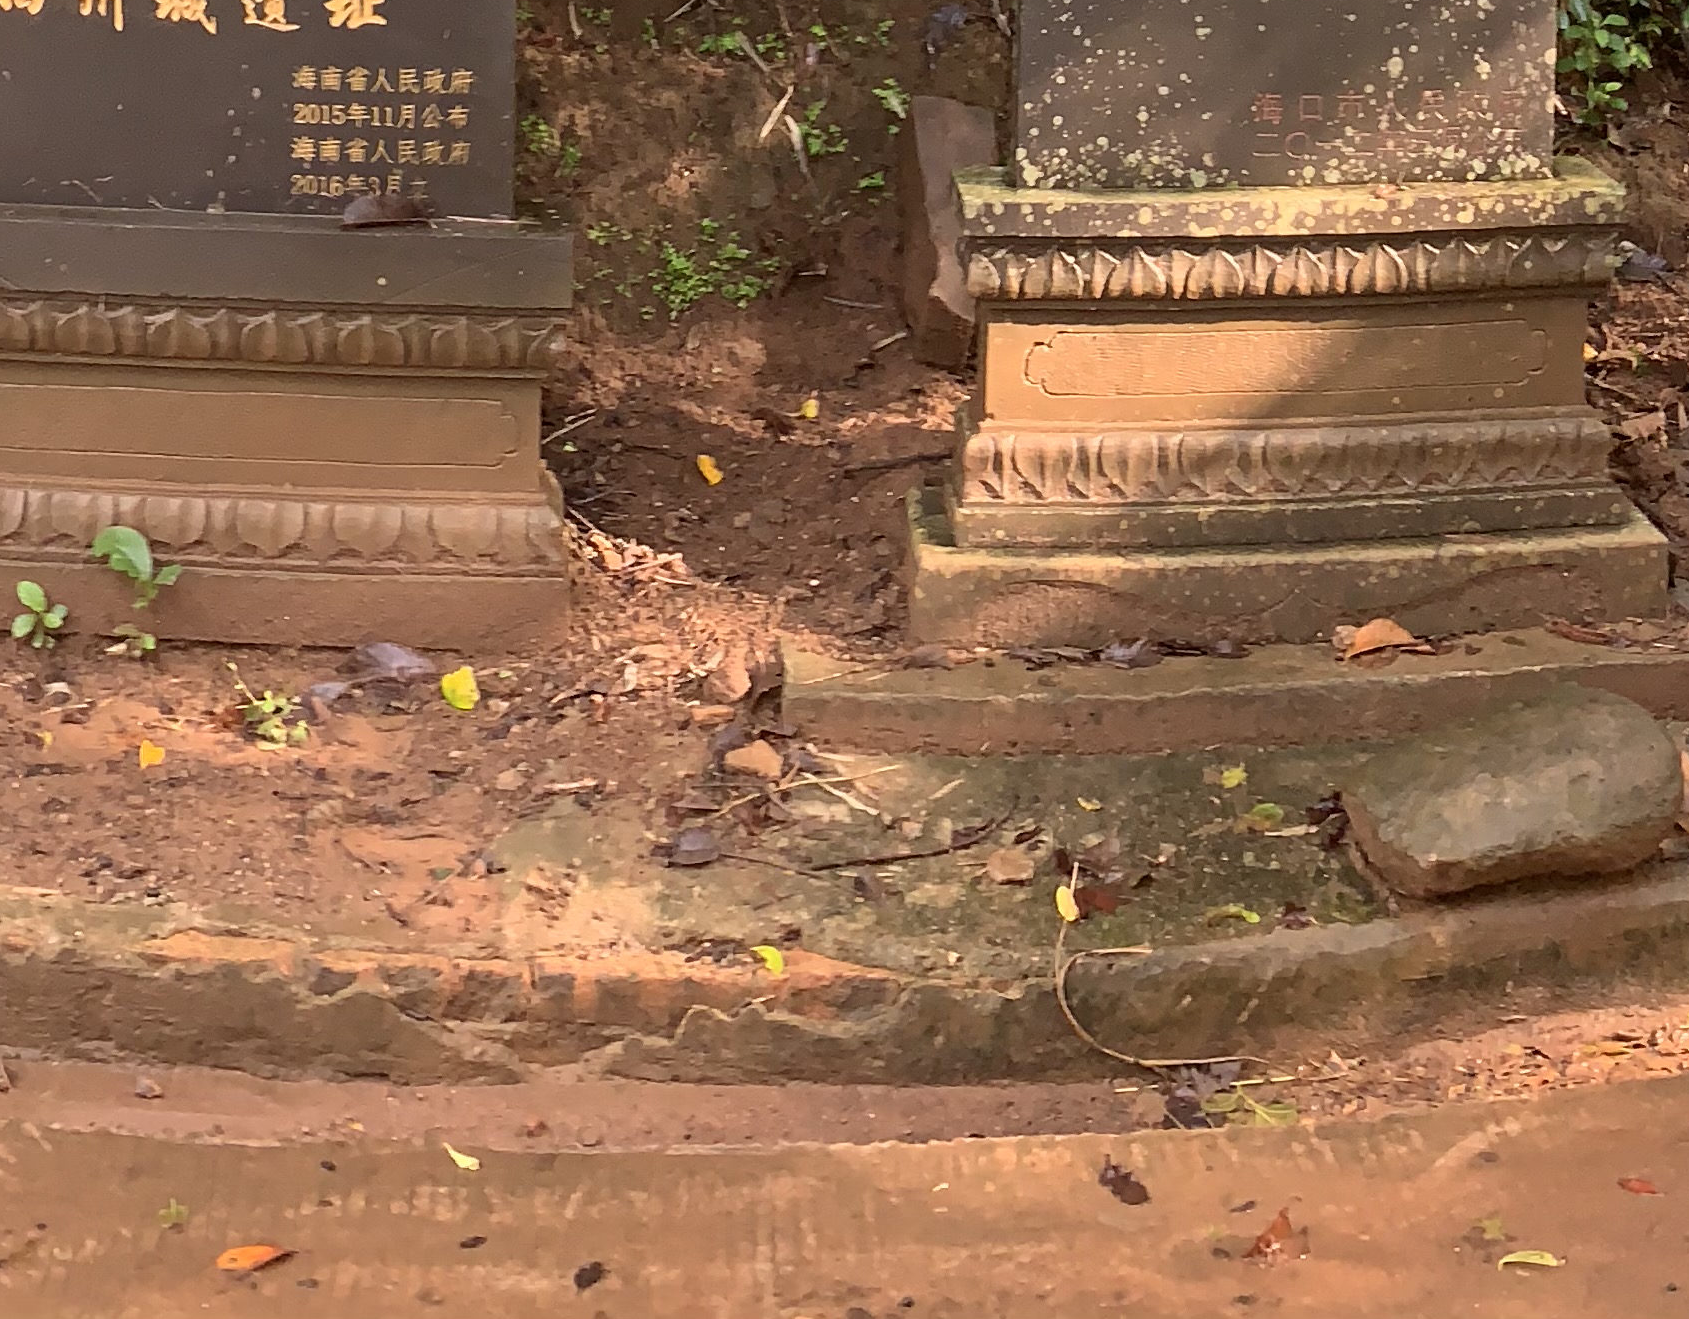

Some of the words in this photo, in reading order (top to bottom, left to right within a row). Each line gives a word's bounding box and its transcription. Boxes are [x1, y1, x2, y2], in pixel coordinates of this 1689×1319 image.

[291, 64, 474, 95] 海南省人民政府
[292, 101, 471, 130] 2015年11月公布
[289, 135, 472, 165] 海南省人民政府
